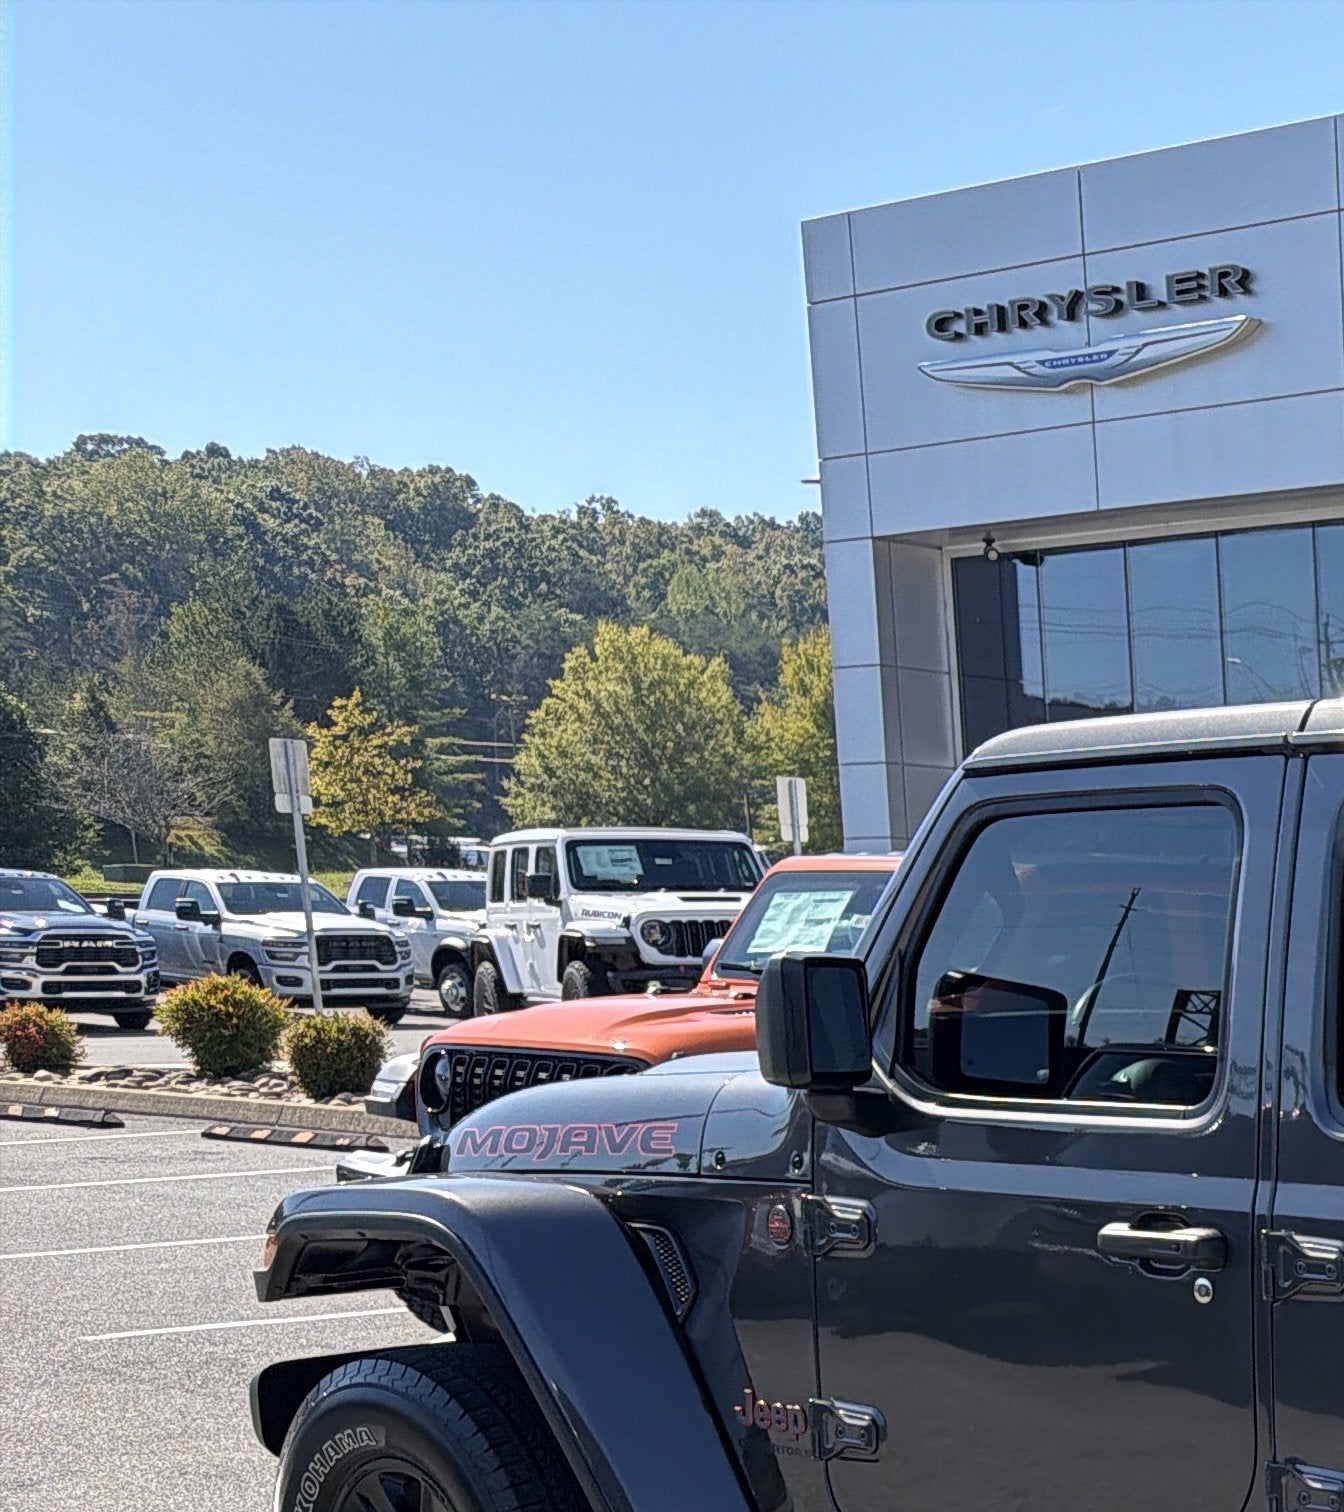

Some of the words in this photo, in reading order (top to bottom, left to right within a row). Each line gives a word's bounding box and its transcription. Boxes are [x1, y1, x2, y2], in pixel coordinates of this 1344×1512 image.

[925, 263, 1257, 341] CHRYSLER
[1044, 352, 1109, 368] CHRYSLER
[581, 908, 622, 920] RUBICON
[63, 939, 113, 948] RAM
[455, 1122, 678, 1164] MOJAVE
[733, 1387, 808, 1441] Jeep
